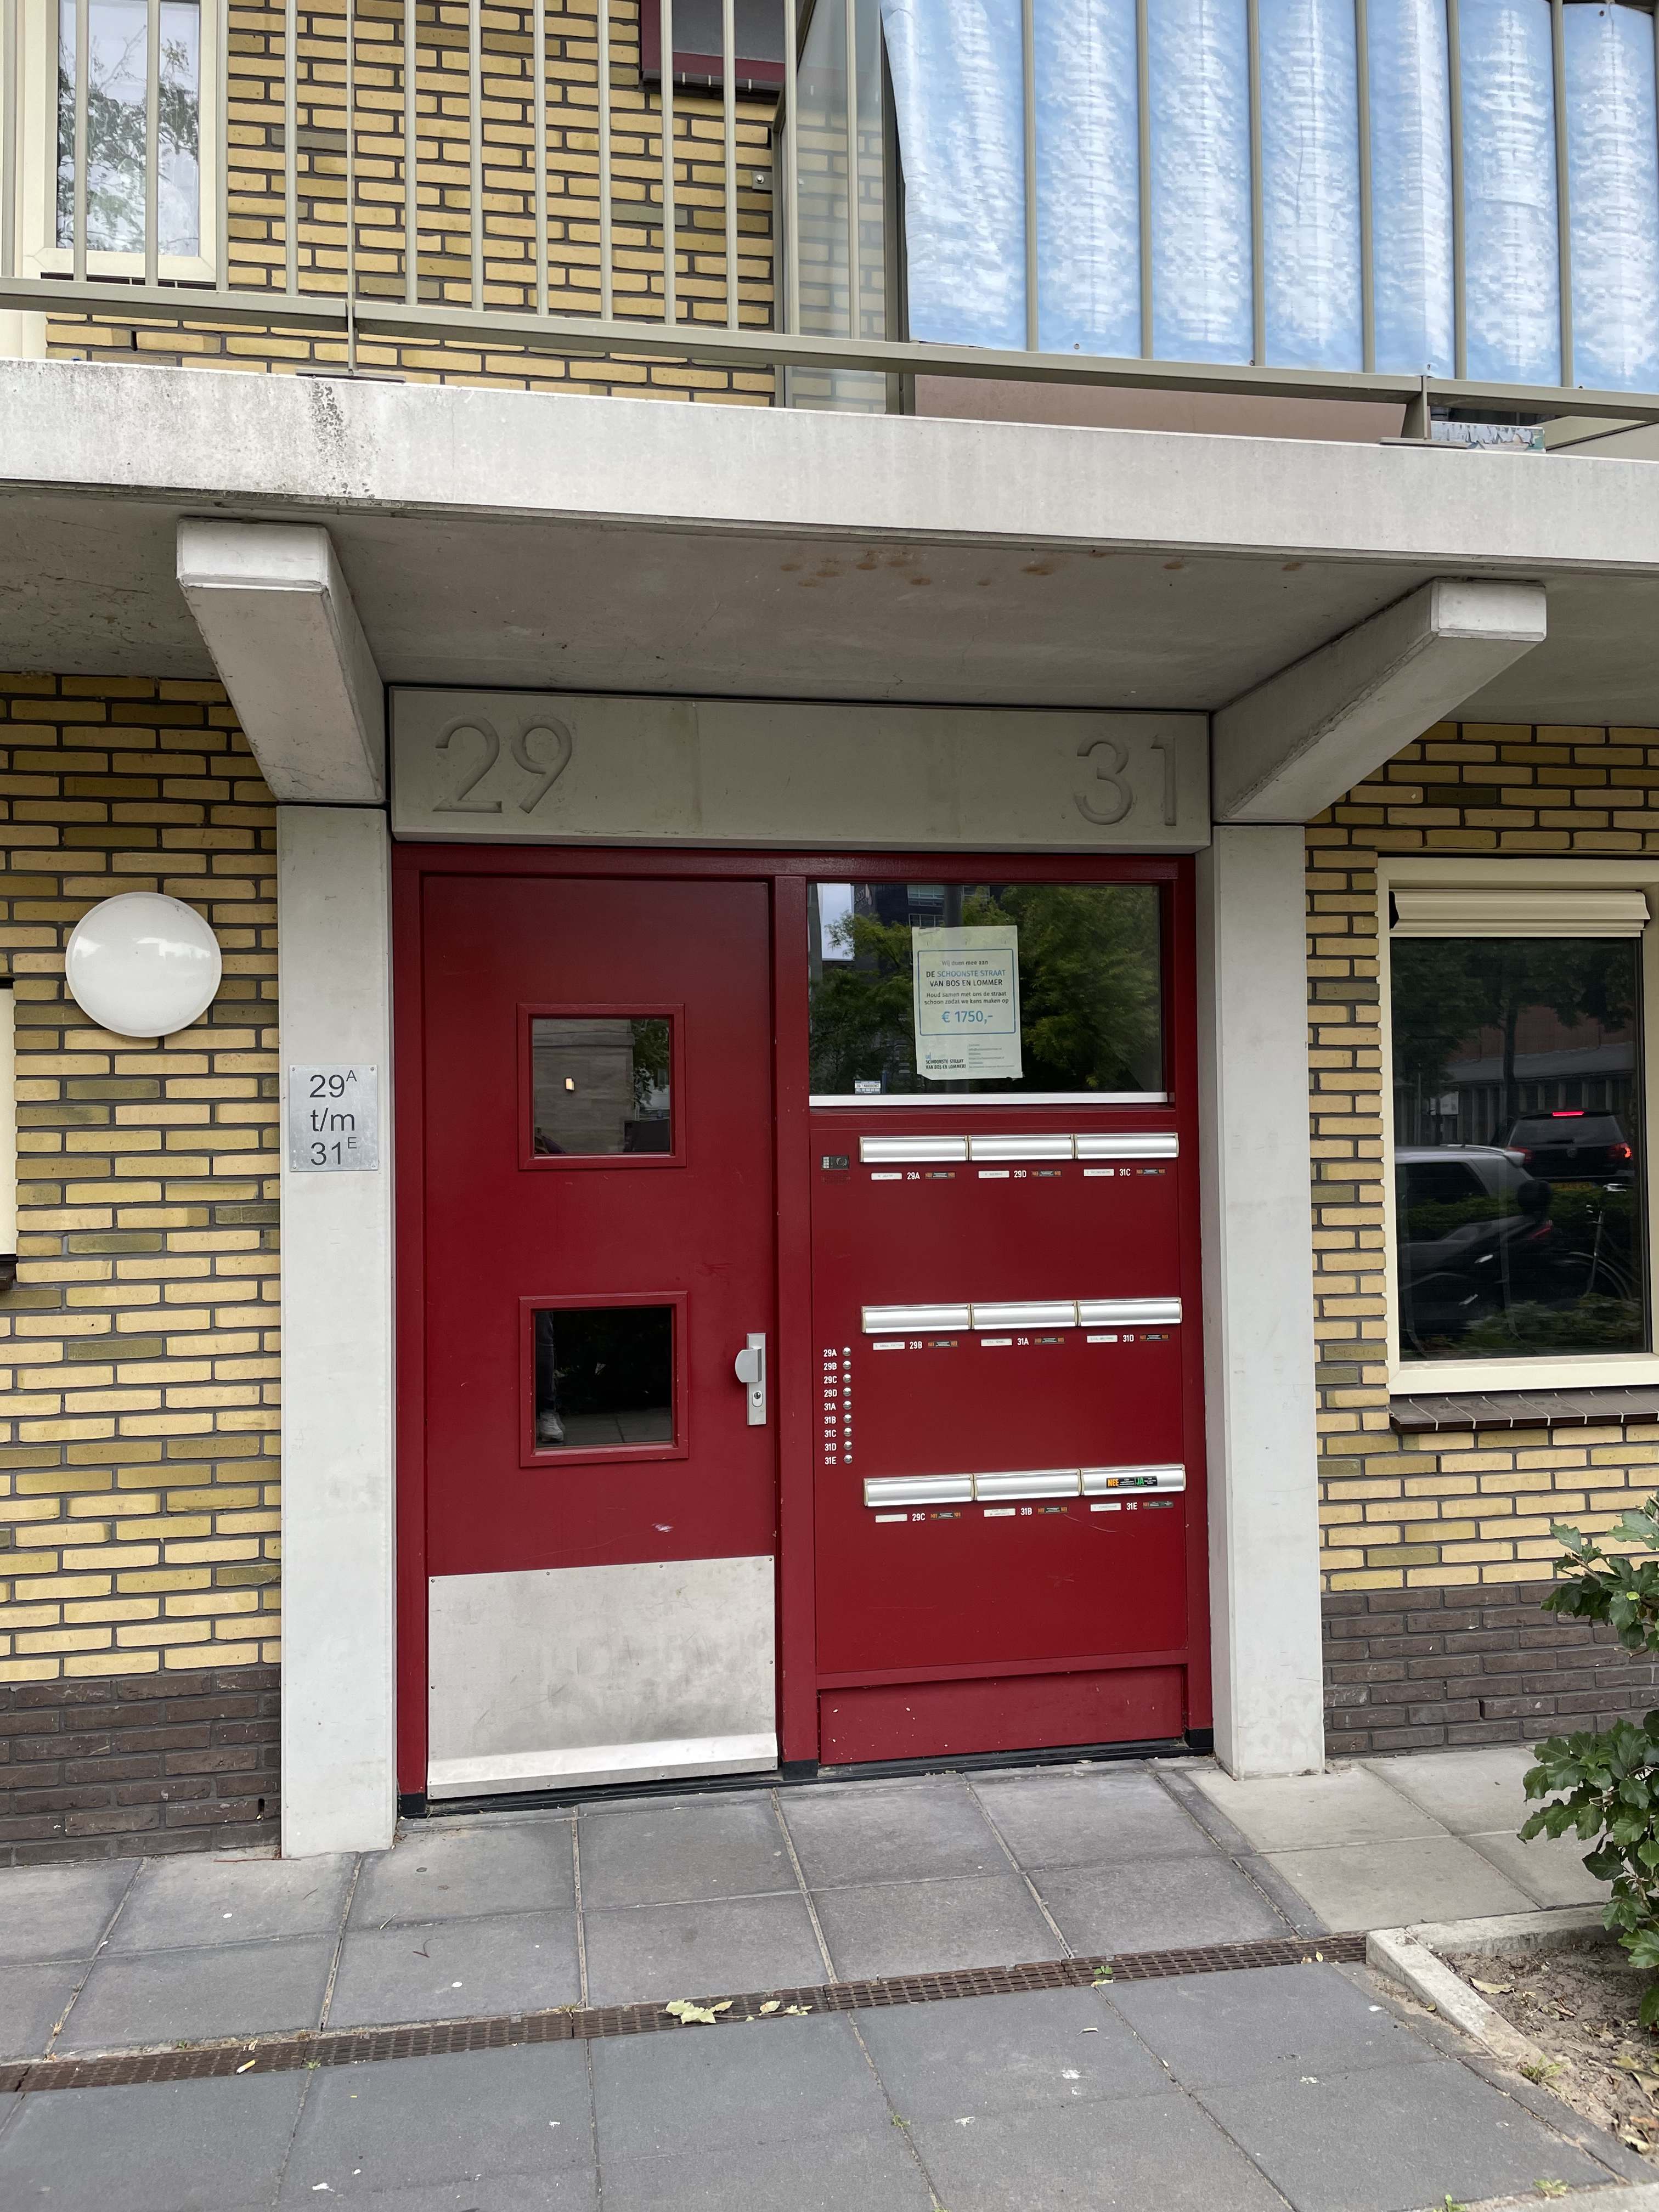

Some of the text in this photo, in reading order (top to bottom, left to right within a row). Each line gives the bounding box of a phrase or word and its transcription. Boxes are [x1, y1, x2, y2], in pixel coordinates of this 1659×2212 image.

[433, 715, 573, 814] 29
[1074, 734, 1177, 826] 31
[941, 1011, 994, 1024] € 1750,-
[310, 1108, 355, 1132] t/m
[907, 1172, 921, 1180] 29A
[1014, 1170, 1026, 1178] 29D
[1119, 1168, 1131, 1176] 31C
[1017, 1338, 1029, 1346] 31A
[1122, 1334, 1134, 1342] 31D
[909, 1341, 923, 1350] 29B
[823, 1348, 837, 1357] 29A
[823, 1362, 837, 1370] 29B
[823, 1375, 837, 1384] 29C
[823, 1389, 837, 1397] 29D
[824, 1402, 837, 1411] 31A
[824, 1416, 837, 1424] 31B
[824, 1429, 837, 1438] 31C
[825, 1443, 837, 1452] 31D
[825, 1456, 837, 1465] 31E
[1107, 1479, 1119, 1487] NEE
[1136, 1477, 1144, 1485] JA
[1126, 1502, 1138, 1510] 31E
[1020, 1507, 1032, 1516] 31B
[912, 1513, 926, 1521] 29C
